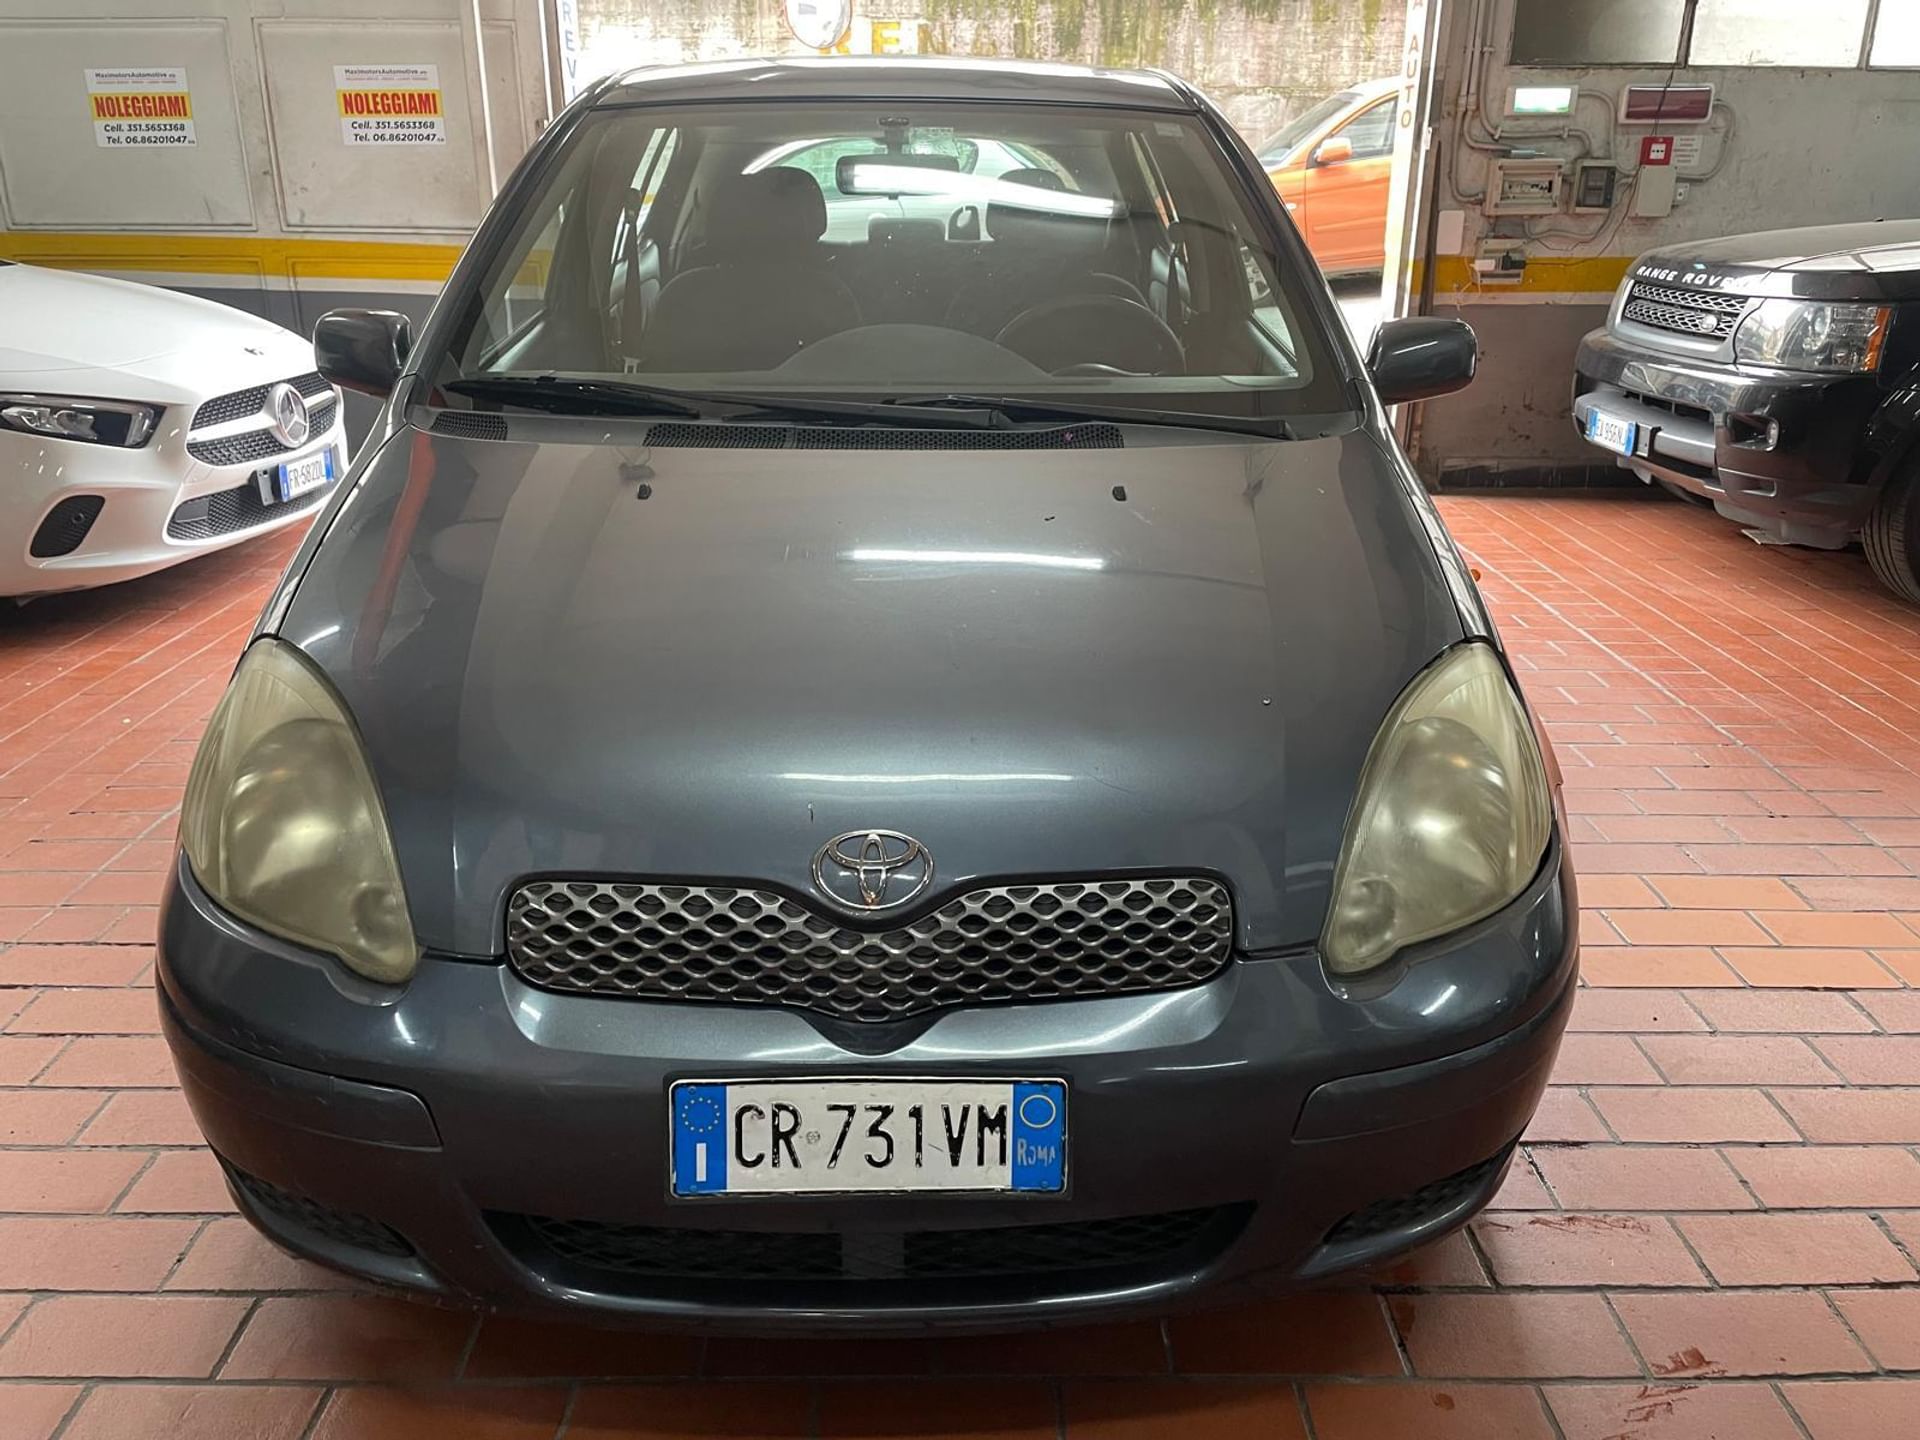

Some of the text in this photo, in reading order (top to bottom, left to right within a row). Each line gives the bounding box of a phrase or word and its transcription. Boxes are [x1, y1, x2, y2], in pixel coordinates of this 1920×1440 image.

[1401, 34, 1419, 128] AUTO
[94, 95, 187, 118] NOLEGGIAMI
[343, 93, 438, 115] NOLEGGIAMI
[104, 123, 124, 132] Cell.
[351, 121, 372, 129] Cell.
[106, 136, 122, 144] Tel.
[125, 135, 187, 144] 06.86201047
[354, 133, 370, 142] Tel.
[373, 133, 437, 142] 06.86201047
[1636, 266, 1745, 290] RANGE ROVE
[734, 1103, 1007, 1169] CR 731VM
